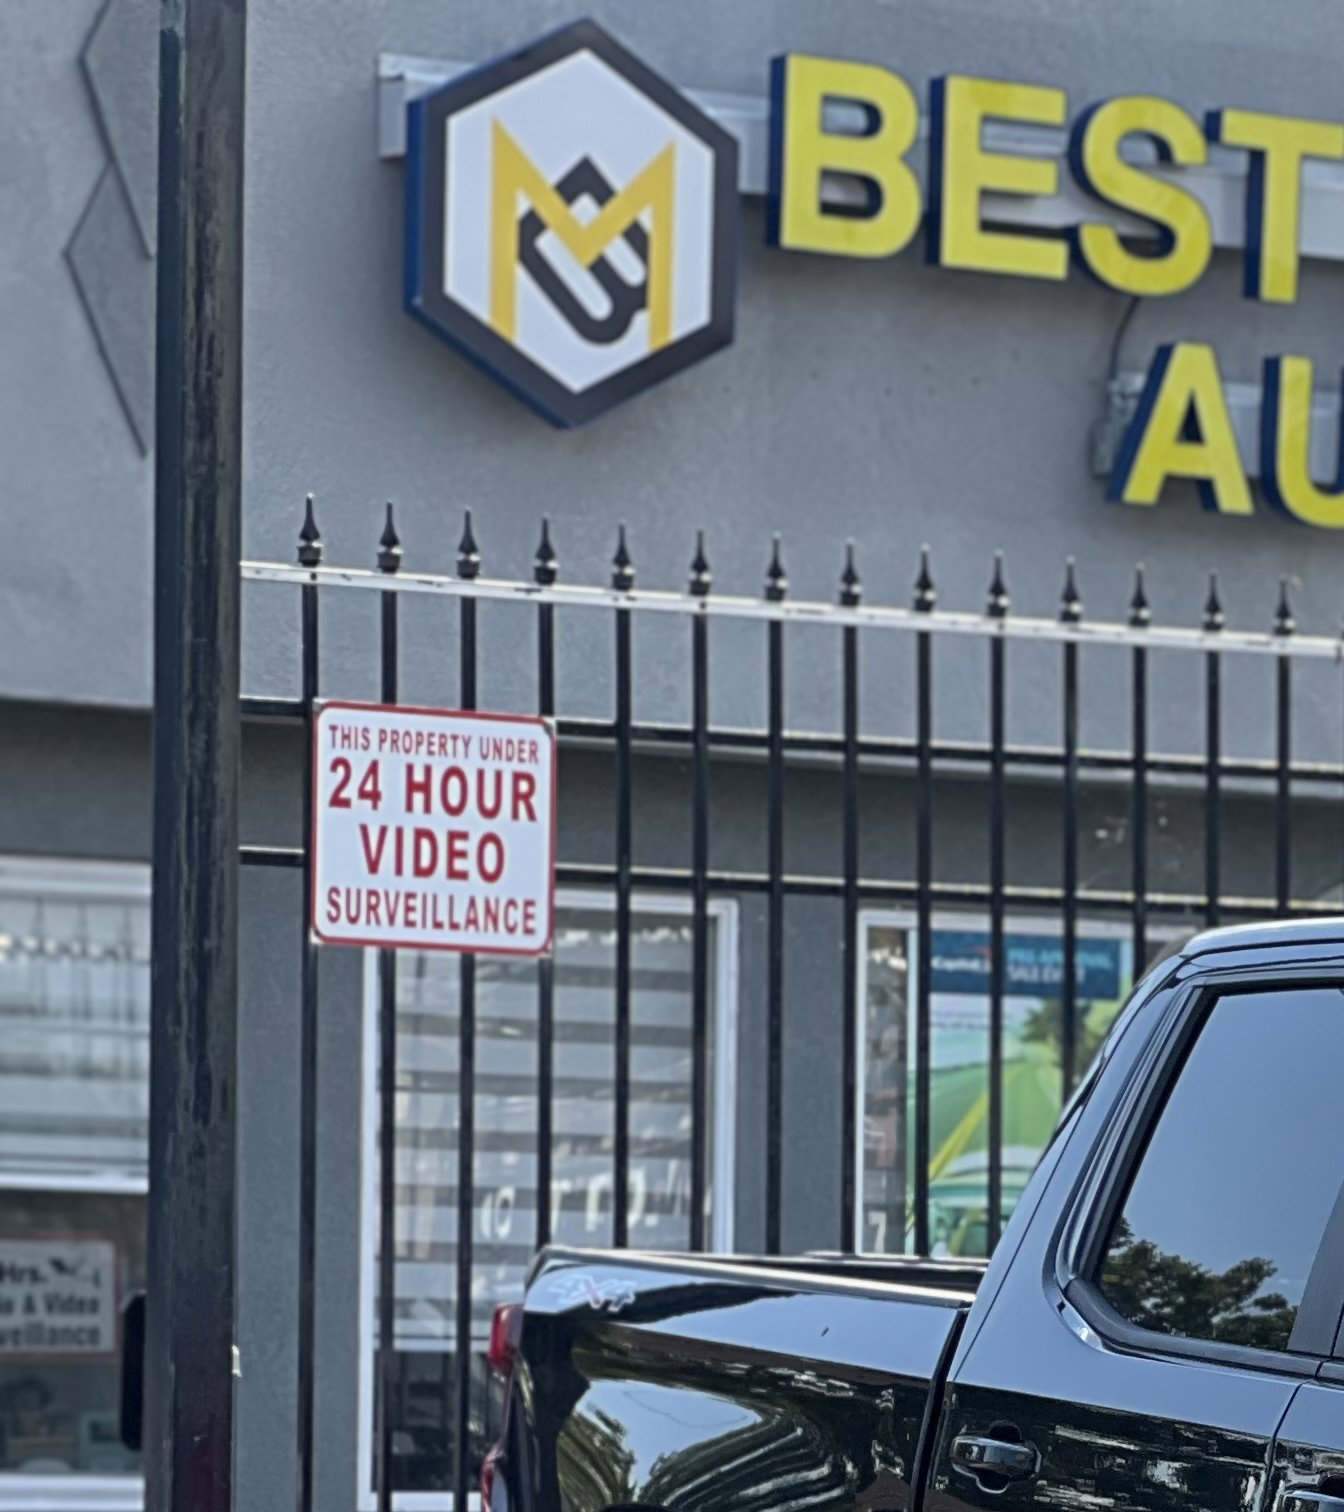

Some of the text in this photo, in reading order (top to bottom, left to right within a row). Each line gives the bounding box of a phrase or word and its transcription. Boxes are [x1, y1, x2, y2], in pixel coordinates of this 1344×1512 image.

[328, 724, 541, 765] THIS PROPERTY UNDER
[328, 756, 538, 823] 24 HOUR
[359, 822, 505, 885] VIDEO
[326, 886, 537, 936] SURVEILLANCE
